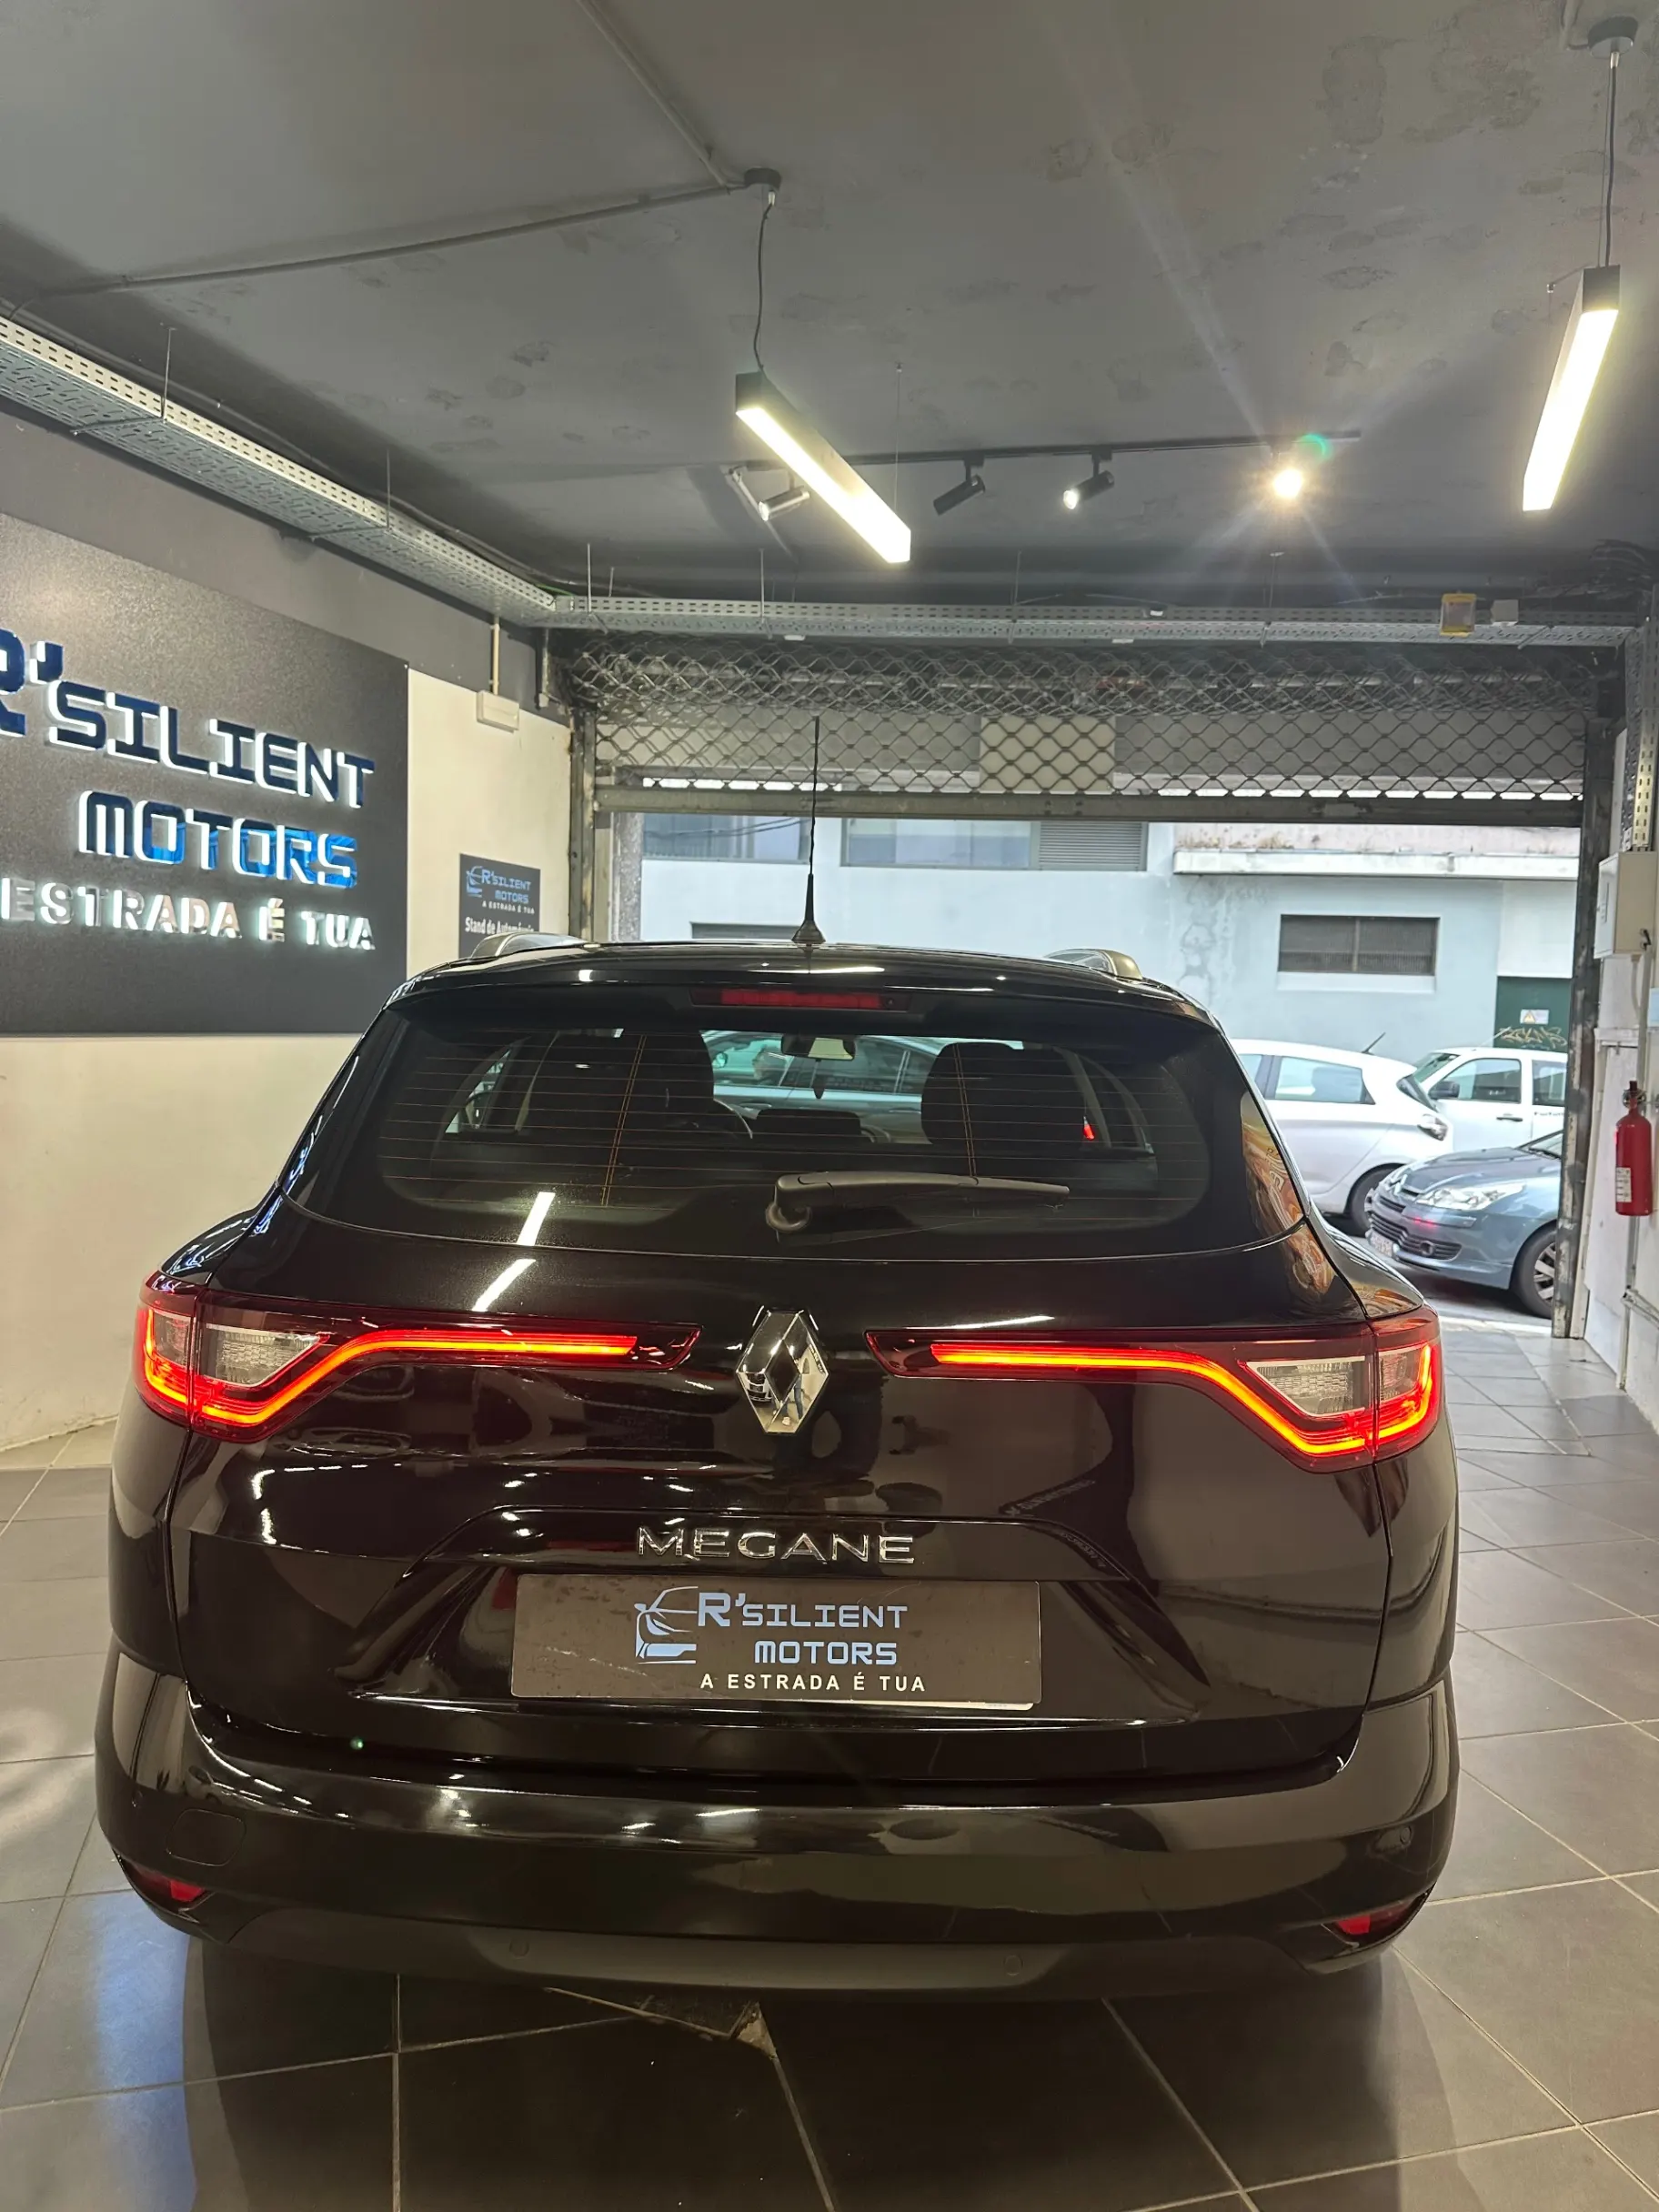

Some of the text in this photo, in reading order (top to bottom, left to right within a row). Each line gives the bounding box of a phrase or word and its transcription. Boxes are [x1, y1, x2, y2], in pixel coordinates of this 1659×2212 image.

[79, 789, 357, 889] MOTORS
[481, 870, 531, 890] R'SILIENT
[488, 901, 516, 911] ESTRADA
[523, 906, 535, 914] TUA
[495, 890, 529, 904] MOTORS
[0, 878, 376, 950] ESTRADA É TUA
[465, 917, 486, 935] Stand
[487, 920, 496, 935] de
[638, 1527, 914, 1564] MEGANE
[698, 1592, 908, 1628] R'SILIENT
[754, 1640, 897, 1665] MOTORS
[700, 1672, 925, 1692] A ESTRADA É TUA
